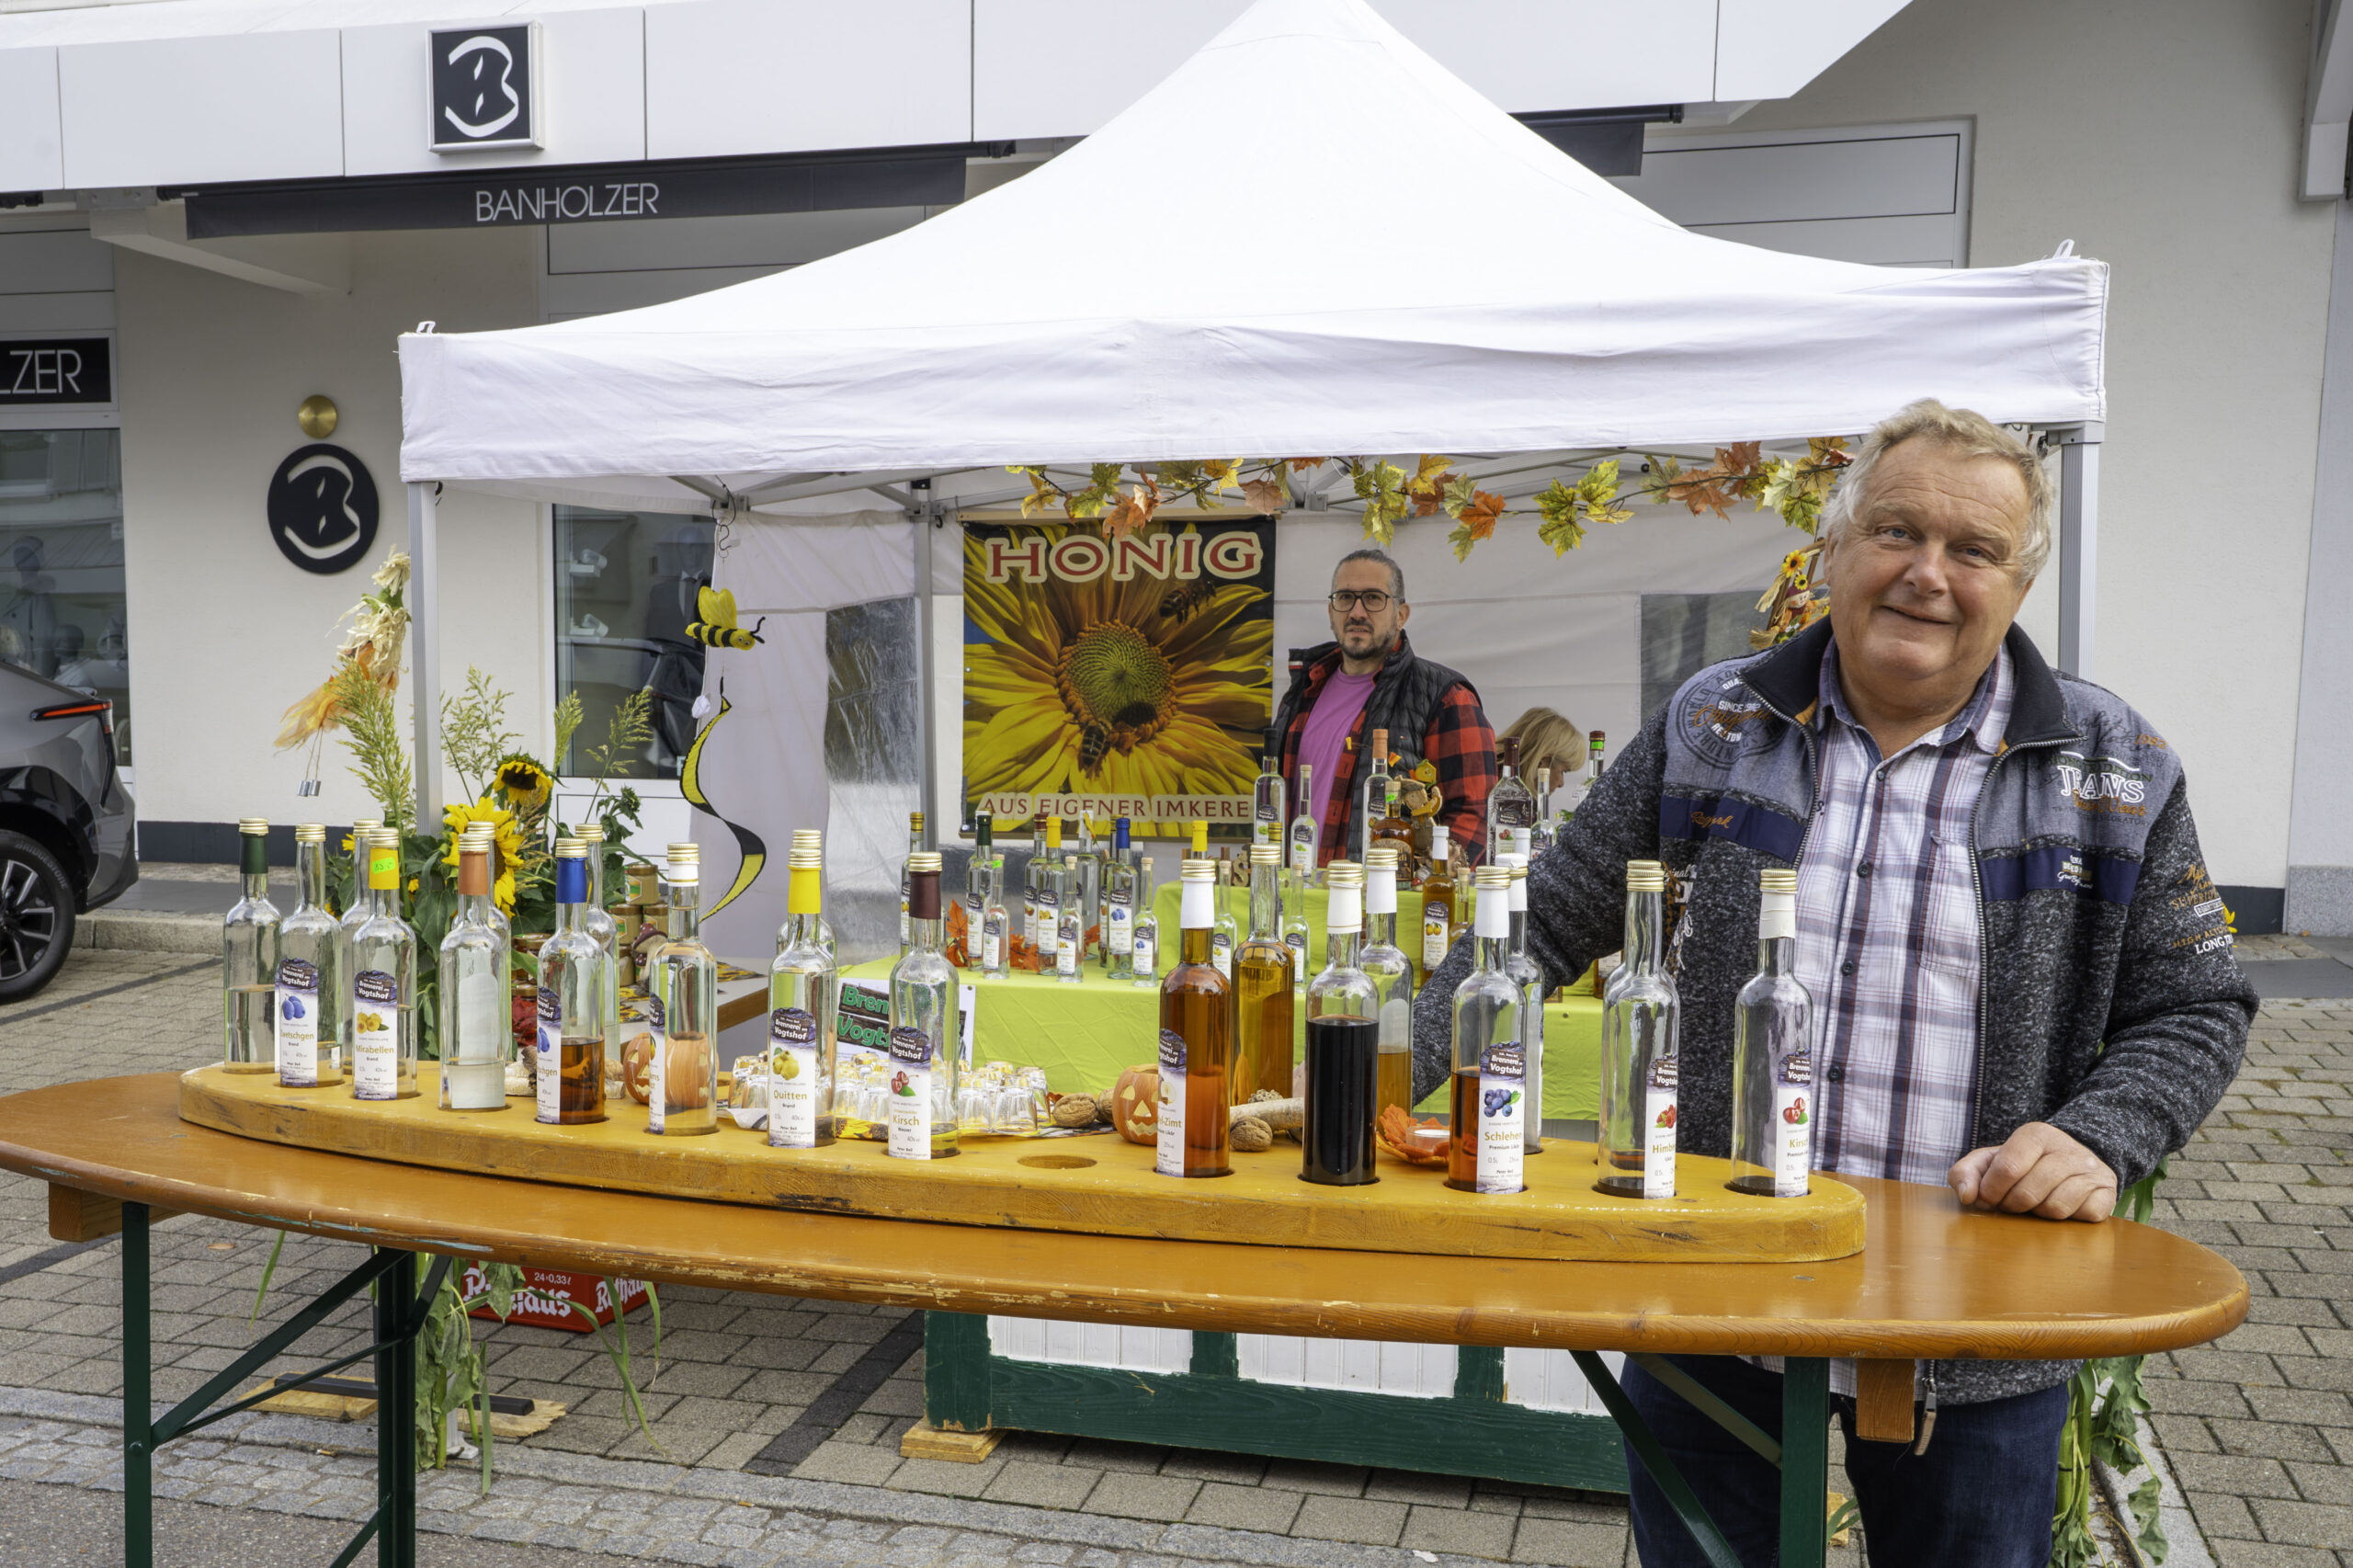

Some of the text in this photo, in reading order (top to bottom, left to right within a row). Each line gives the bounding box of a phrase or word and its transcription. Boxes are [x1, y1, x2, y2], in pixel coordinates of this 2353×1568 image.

[476, 183, 659, 222] BANHOLZER
[989, 536, 1257, 578] HONIG
[1718, 699, 1745, 713] SINCE
[2057, 765, 2145, 803] JEANS
[983, 798, 1249, 818] AUS EIGENER IMKERE
[2194, 936, 2224, 954] LONG
[358, 987, 389, 999] Vogtshof
[775, 1018, 801, 1030] Brennerei
[774, 1026, 807, 1040] Vogtshof
[356, 1045, 394, 1054] Mirabellen
[892, 1045, 922, 1060] Vogtshof
[1491, 1054, 1519, 1066] Brennerei
[1489, 1062, 1522, 1075] Vogtshof
[773, 1089, 807, 1101] Quitten
[892, 1114, 919, 1126] Kirsch
[1484, 1131, 1522, 1142] Schlehen
